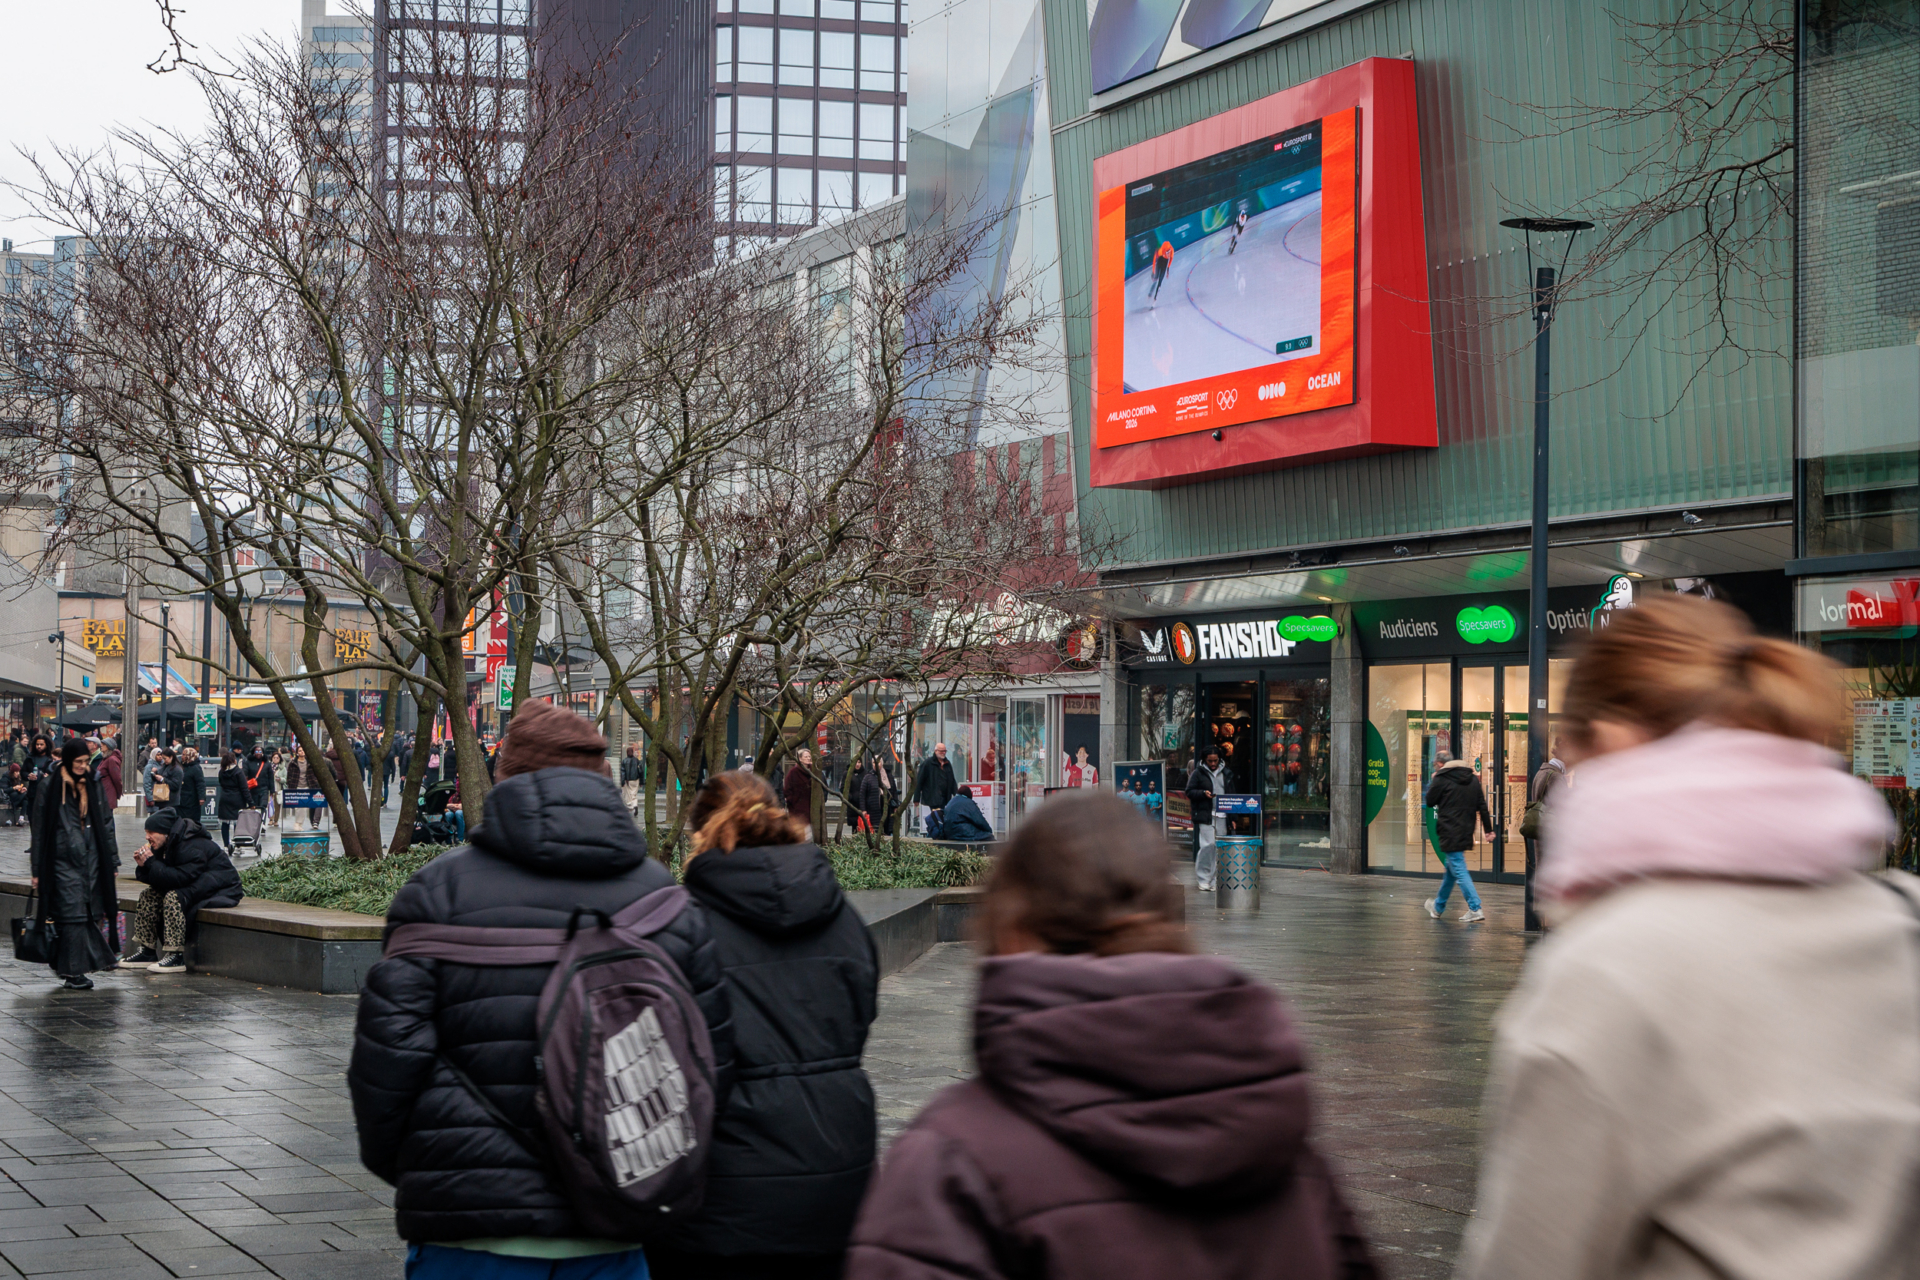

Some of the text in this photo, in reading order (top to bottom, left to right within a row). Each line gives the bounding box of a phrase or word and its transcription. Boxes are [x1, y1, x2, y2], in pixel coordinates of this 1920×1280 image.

[1308, 371, 1341, 390] OCEAN
[1176, 392, 1208, 406] EUROSPORT
[1106, 404, 1157, 423] MILANO CORTINA
[1125, 419, 1138, 429] 2026
[1285, 623, 1334, 633] Specsavers
[1379, 617, 1439, 639] Audiciens
[1459, 618, 1506, 634] Specsavers
[1546, 607, 1590, 635] Optici
[334, 628, 371, 645] FAIR
[334, 643, 371, 659] PLAY
[1367, 758, 1385, 768] Gratis
[1367, 769, 1381, 777] oog-
[1367, 777, 1387, 788] meting
